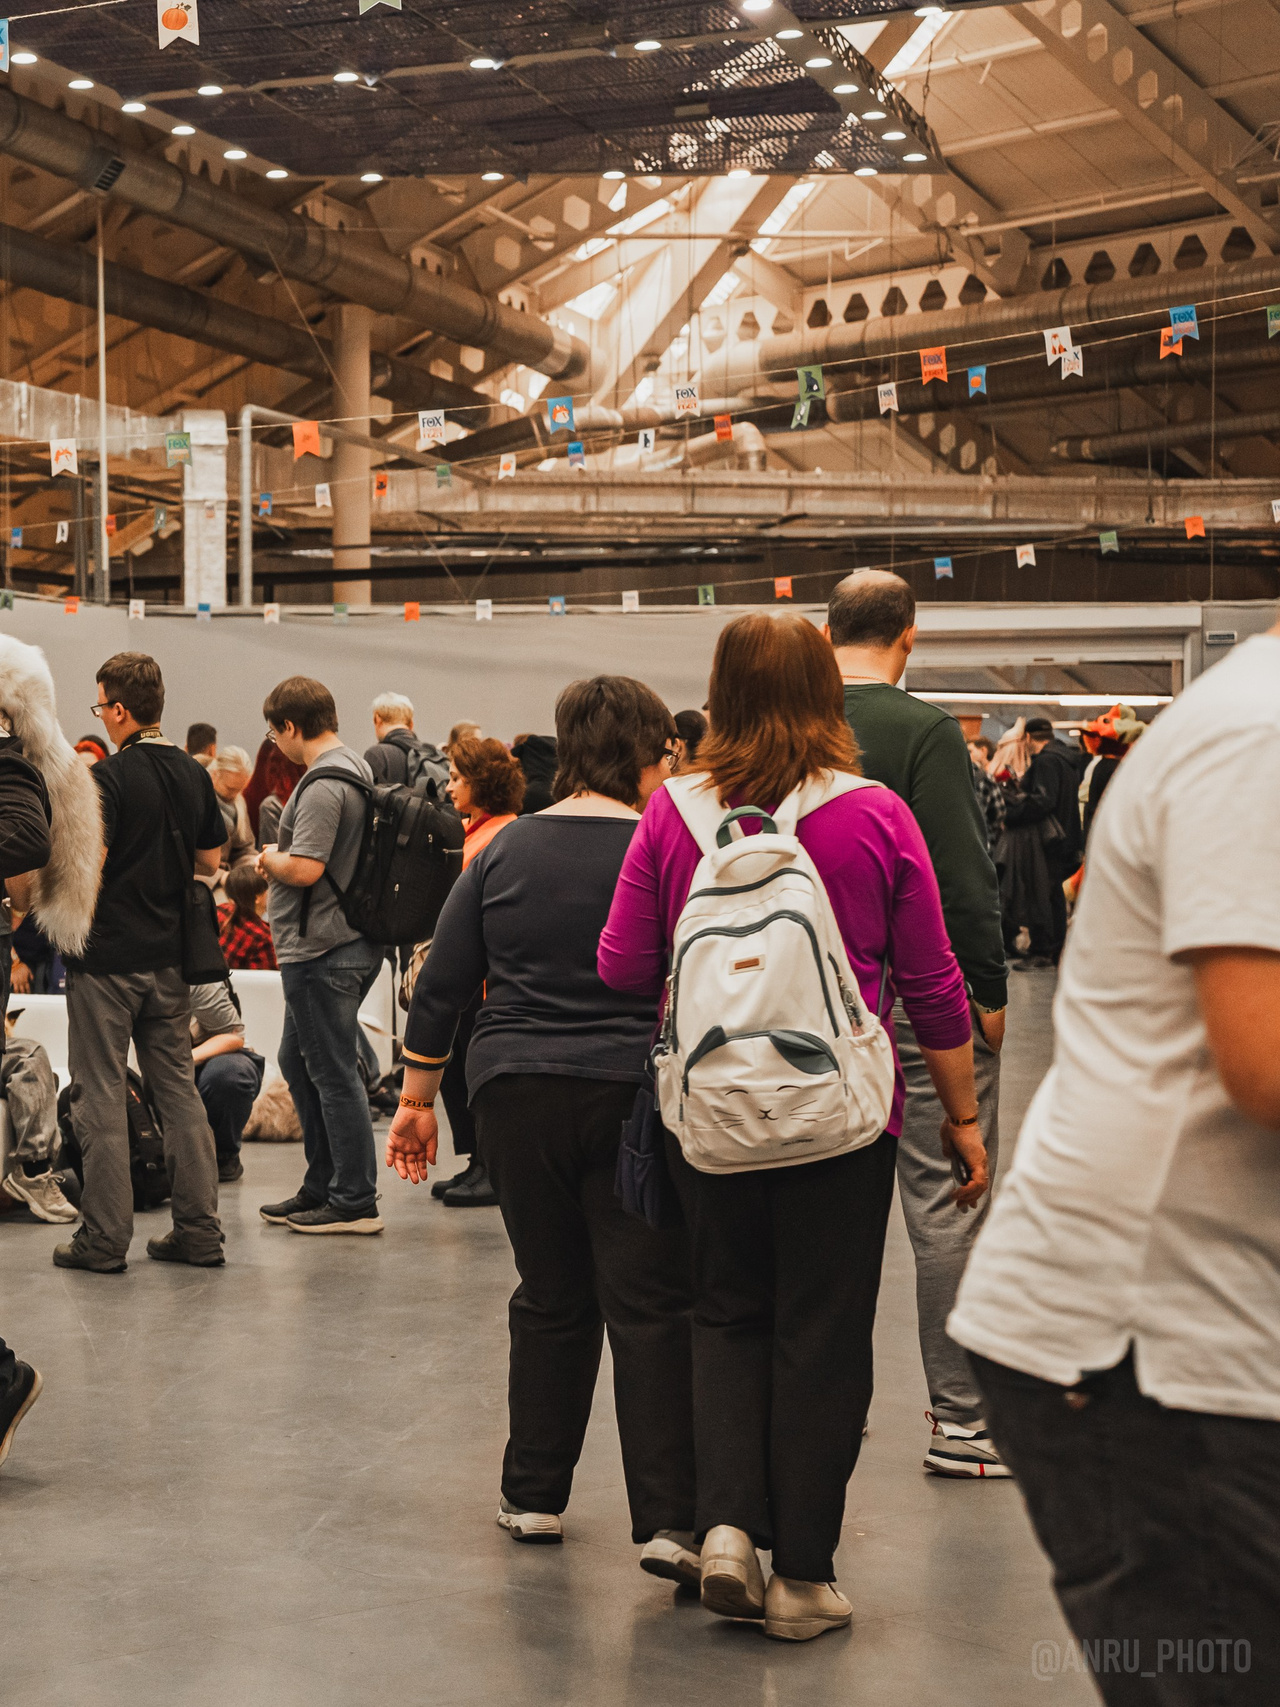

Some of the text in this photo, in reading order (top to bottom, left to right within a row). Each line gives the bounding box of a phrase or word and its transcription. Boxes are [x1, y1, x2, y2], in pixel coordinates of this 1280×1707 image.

[1173, 311, 1194, 323] FOX
[923, 354, 943, 365] FOX
[675, 387, 696, 400] FOX
[422, 416, 442, 428] FOX
[168, 439, 188, 449] FOX
